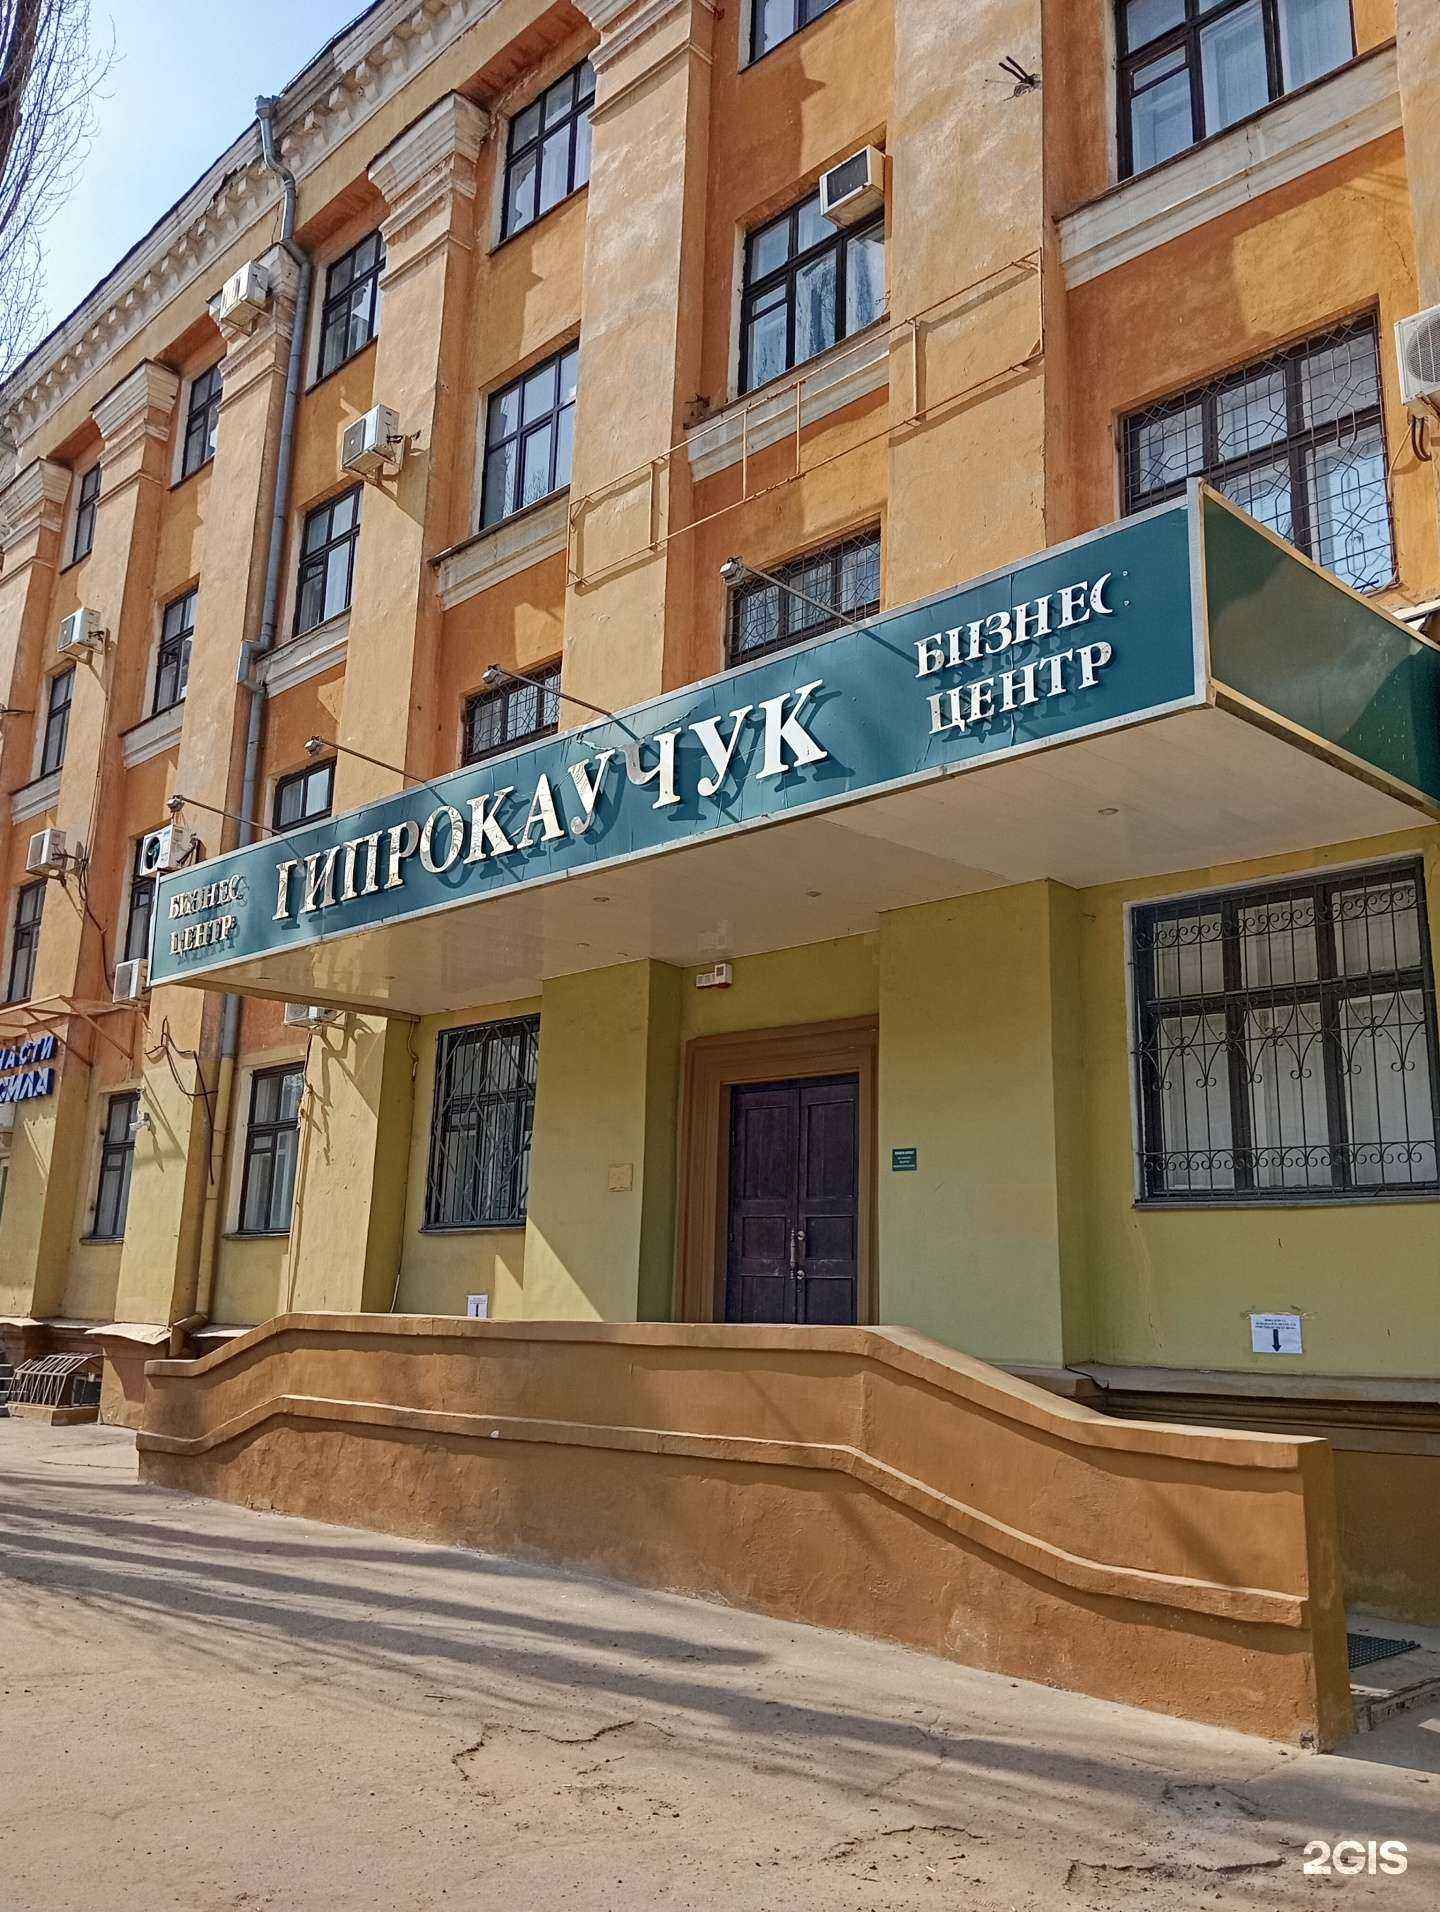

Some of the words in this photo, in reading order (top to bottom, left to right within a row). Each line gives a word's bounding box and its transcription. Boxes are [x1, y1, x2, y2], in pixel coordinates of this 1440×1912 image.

[926, 641, 1113, 735] ЦЕНТР
[271, 678, 829, 921] ГИПРОКАУЧУК
[167, 874, 243, 920] БИЗНЕС
[168, 915, 238, 957] ЦЕНТР
